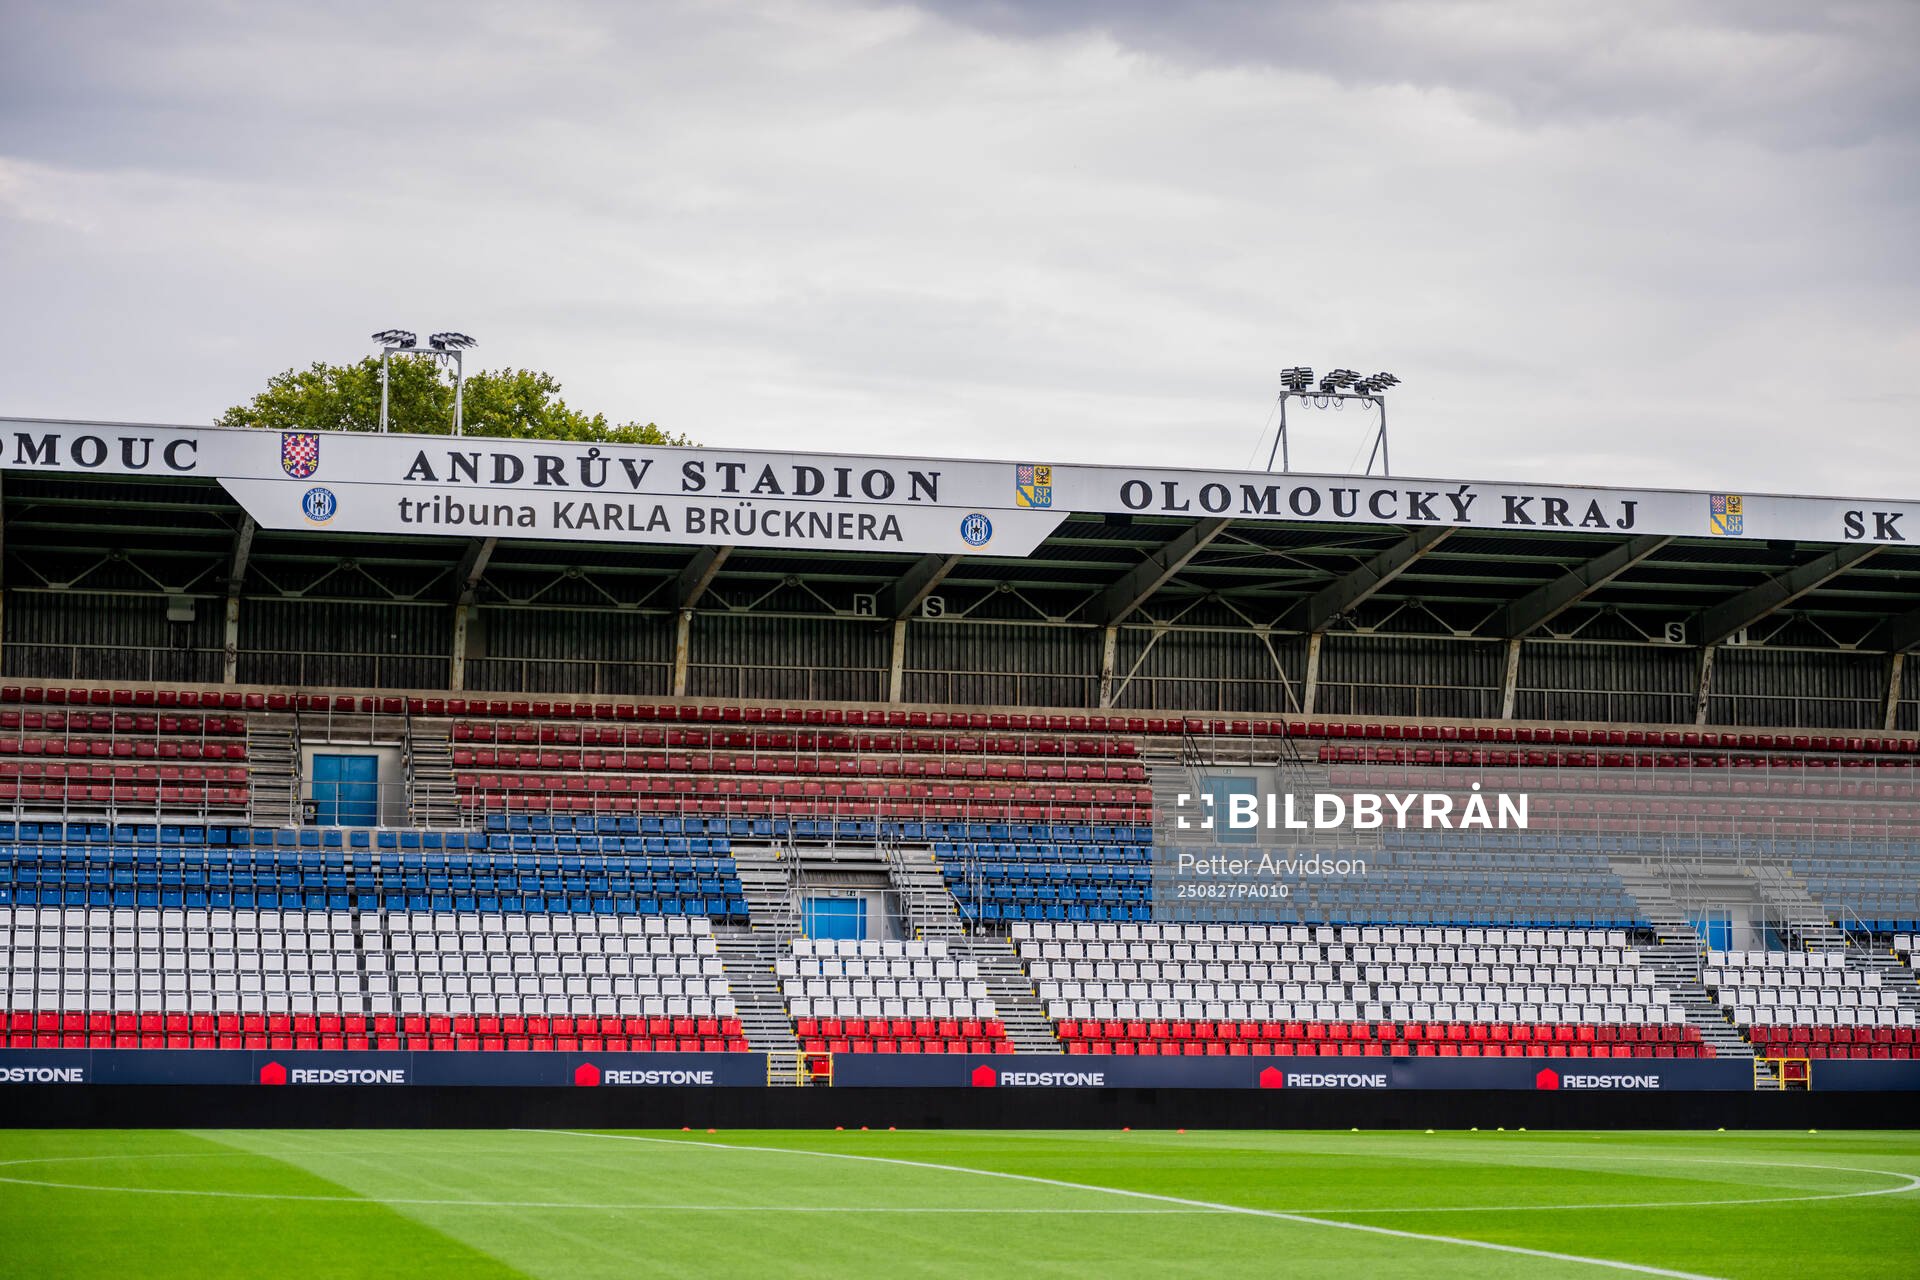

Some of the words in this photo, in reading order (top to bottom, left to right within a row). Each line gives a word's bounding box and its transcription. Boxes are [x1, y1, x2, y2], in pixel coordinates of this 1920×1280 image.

[0, 433, 197, 471] MOUC
[403, 448, 653, 489] ANDRŮV
[682, 461, 940, 502] STADION
[1120, 480, 1477, 522] OLOMOUCKÝ
[1502, 496, 1637, 529] KRAJ
[399, 495, 535, 527] tribuna
[554, 502, 670, 532] KARLA
[686, 501, 903, 541] BRÜCKNERA
[1844, 511, 1905, 540] SK
[856, 596, 873, 615] R
[926, 598, 942, 617] S
[1669, 624, 1683, 642] S
[291, 1069, 405, 1083] REDSTONE
[605, 1070, 713, 1084] REDSTONE
[1001, 1072, 1104, 1085] REDSTONE
[1287, 1074, 1386, 1087] REDSTONE
[1563, 1075, 1659, 1088] REDSTONE
